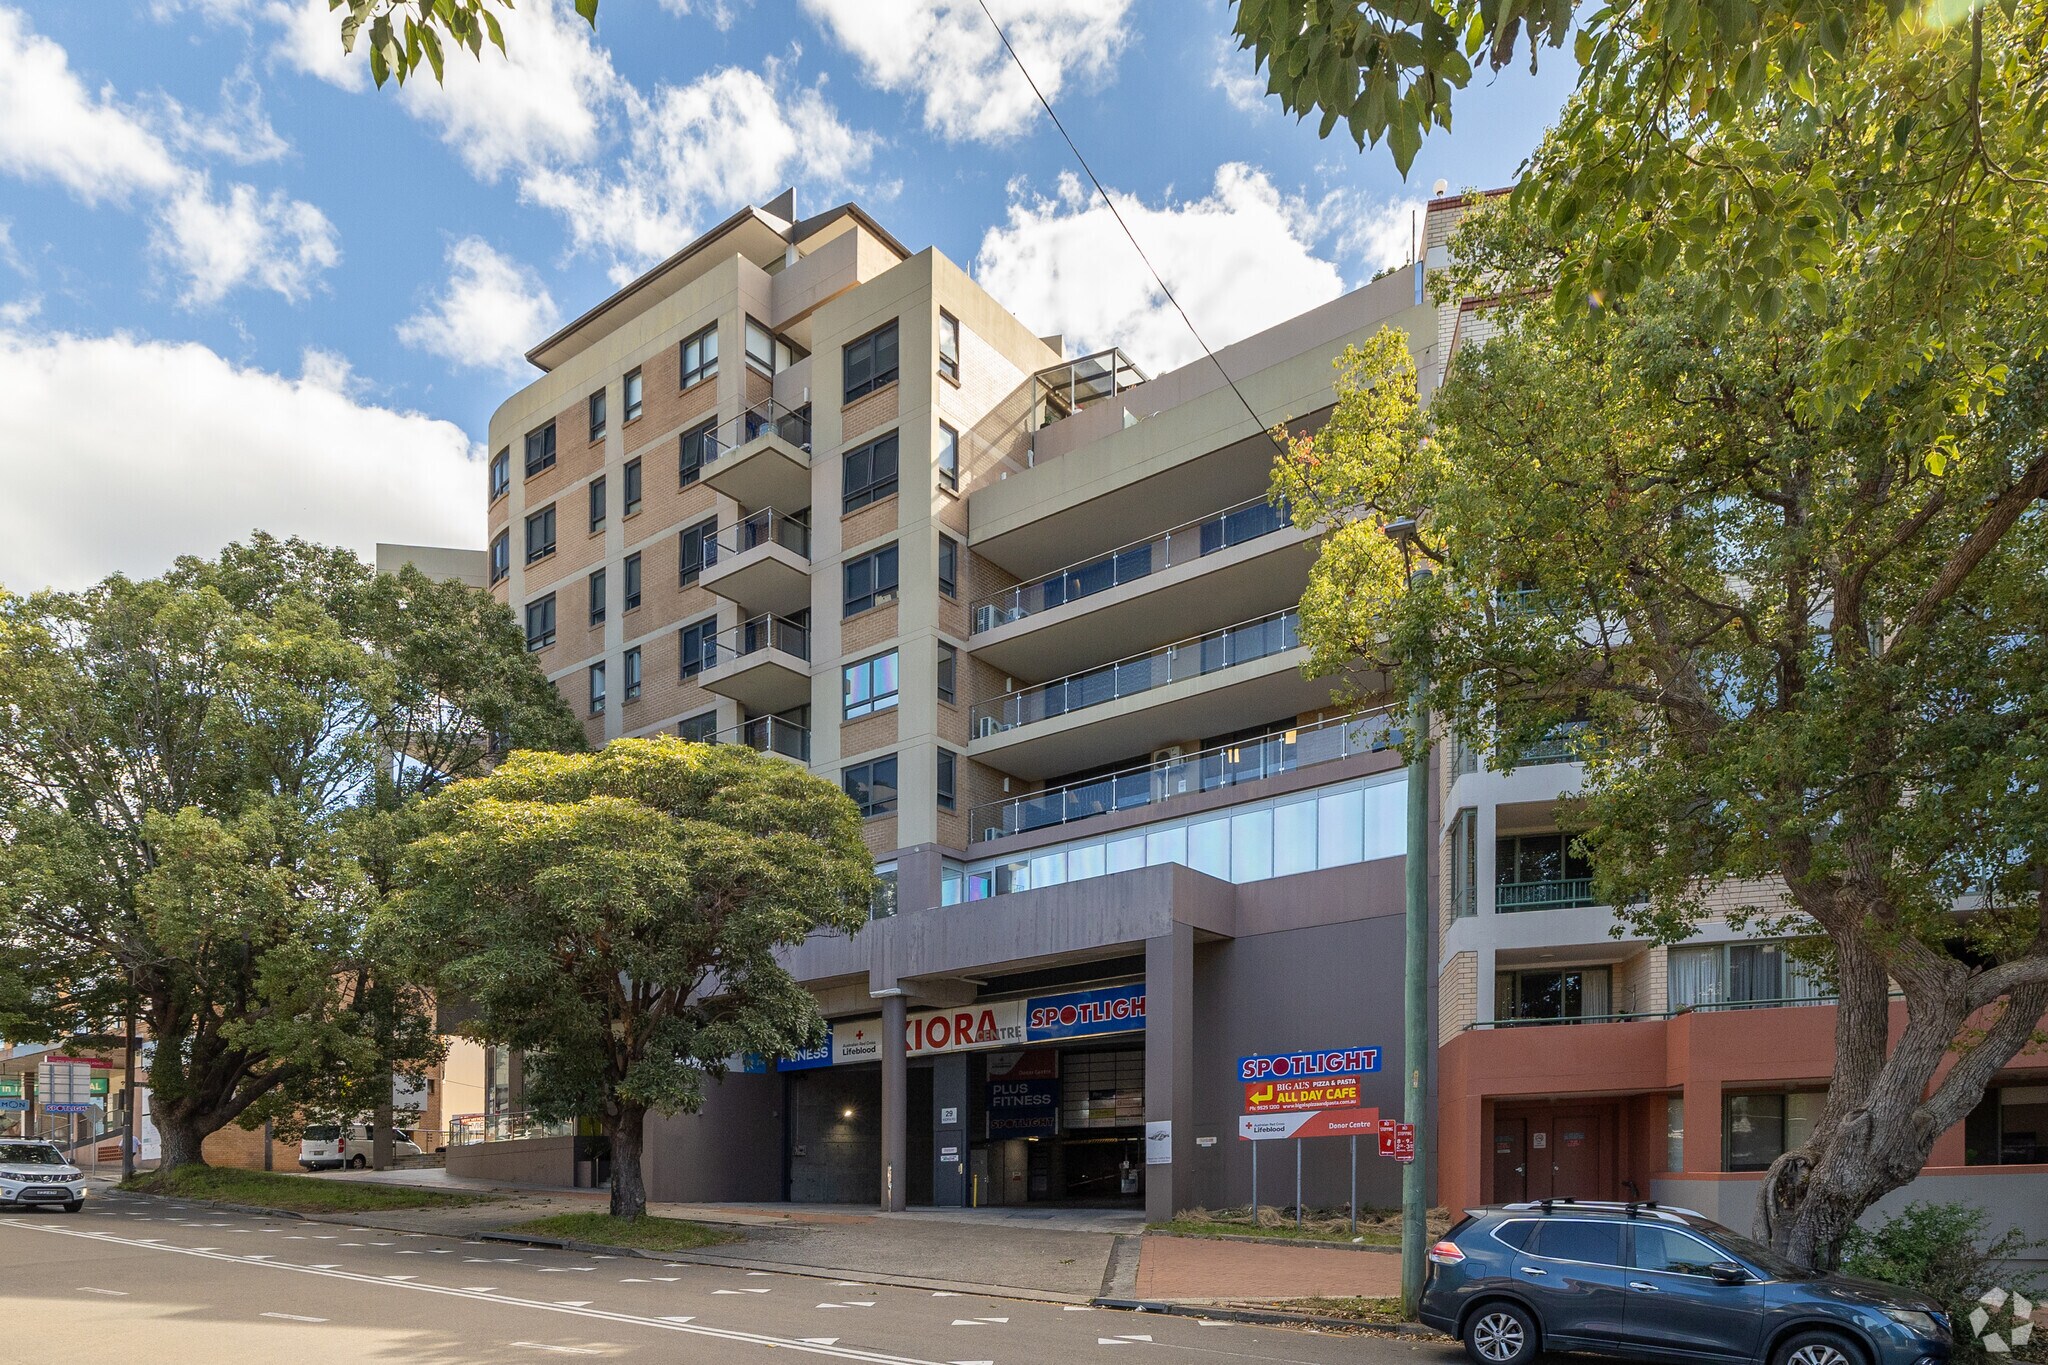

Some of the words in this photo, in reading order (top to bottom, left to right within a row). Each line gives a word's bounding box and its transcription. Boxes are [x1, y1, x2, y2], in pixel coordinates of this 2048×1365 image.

[1031, 995, 1146, 1028] SPOTLIGH
[976, 1026, 1021, 1041] CENTRE
[780, 1046, 829, 1063] FTNESS
[842, 1045, 876, 1056] Lifeblood
[1242, 1049, 1377, 1079] SPOTLIGHT
[993, 1083, 1028, 1095] PLUS
[1277, 1082, 1292, 1091] BIG
[1293, 1081, 1310, 1089] AL'S
[993, 1094, 1051, 1107] FITNESS
[1276, 1092, 1298, 1103] ALL
[1300, 1090, 1323, 1101] DAY
[1326, 1087, 1357, 1099] CAFE
[991, 1116, 1054, 1129] SPOTLIGHT
[1328, 1122, 1348, 1130] Donor
[1349, 1120, 1371, 1129] Centre
